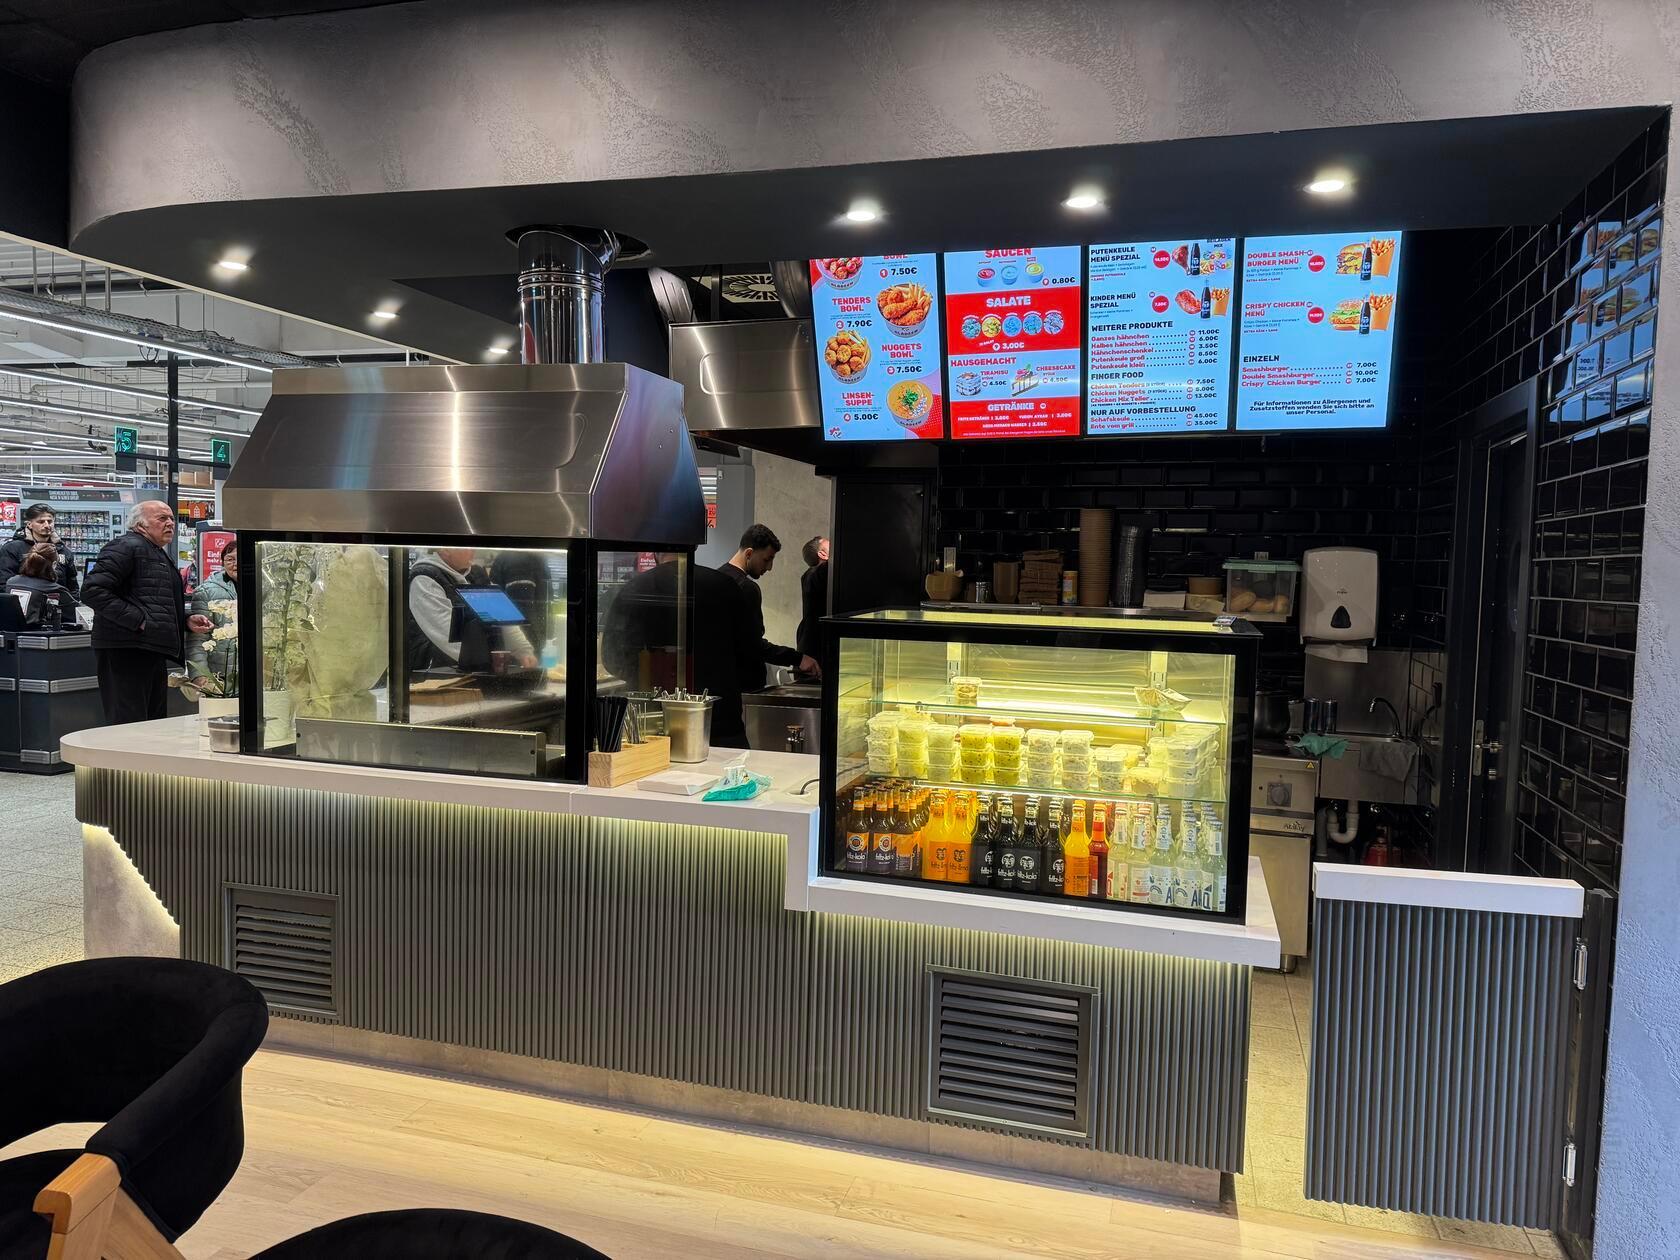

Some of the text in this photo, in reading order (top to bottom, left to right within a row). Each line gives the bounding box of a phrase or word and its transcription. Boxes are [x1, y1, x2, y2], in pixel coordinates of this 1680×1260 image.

[985, 248, 1032, 258] SAUCEN
[1090, 246, 1136, 255] PUTENKEULE
[892, 267, 917, 275] 7.50€
[832, 297, 871, 305] TENDERS
[986, 296, 1032, 307] SALATE
[1245, 309, 1265, 317] MENÜ
[1092, 321, 1174, 332] WEITERE PRODUKTE
[882, 343, 922, 352] NUGGETS
[950, 357, 1016, 367] HAUSGEMACHT
[1118, 389, 1146, 397] Nuggets
[988, 402, 1034, 411] GETRÄNKE
[1126, 406, 1196, 414] VORBESTELLUNG
[122, 432, 132, 451] 5
[217, 444, 226, 462] 4
